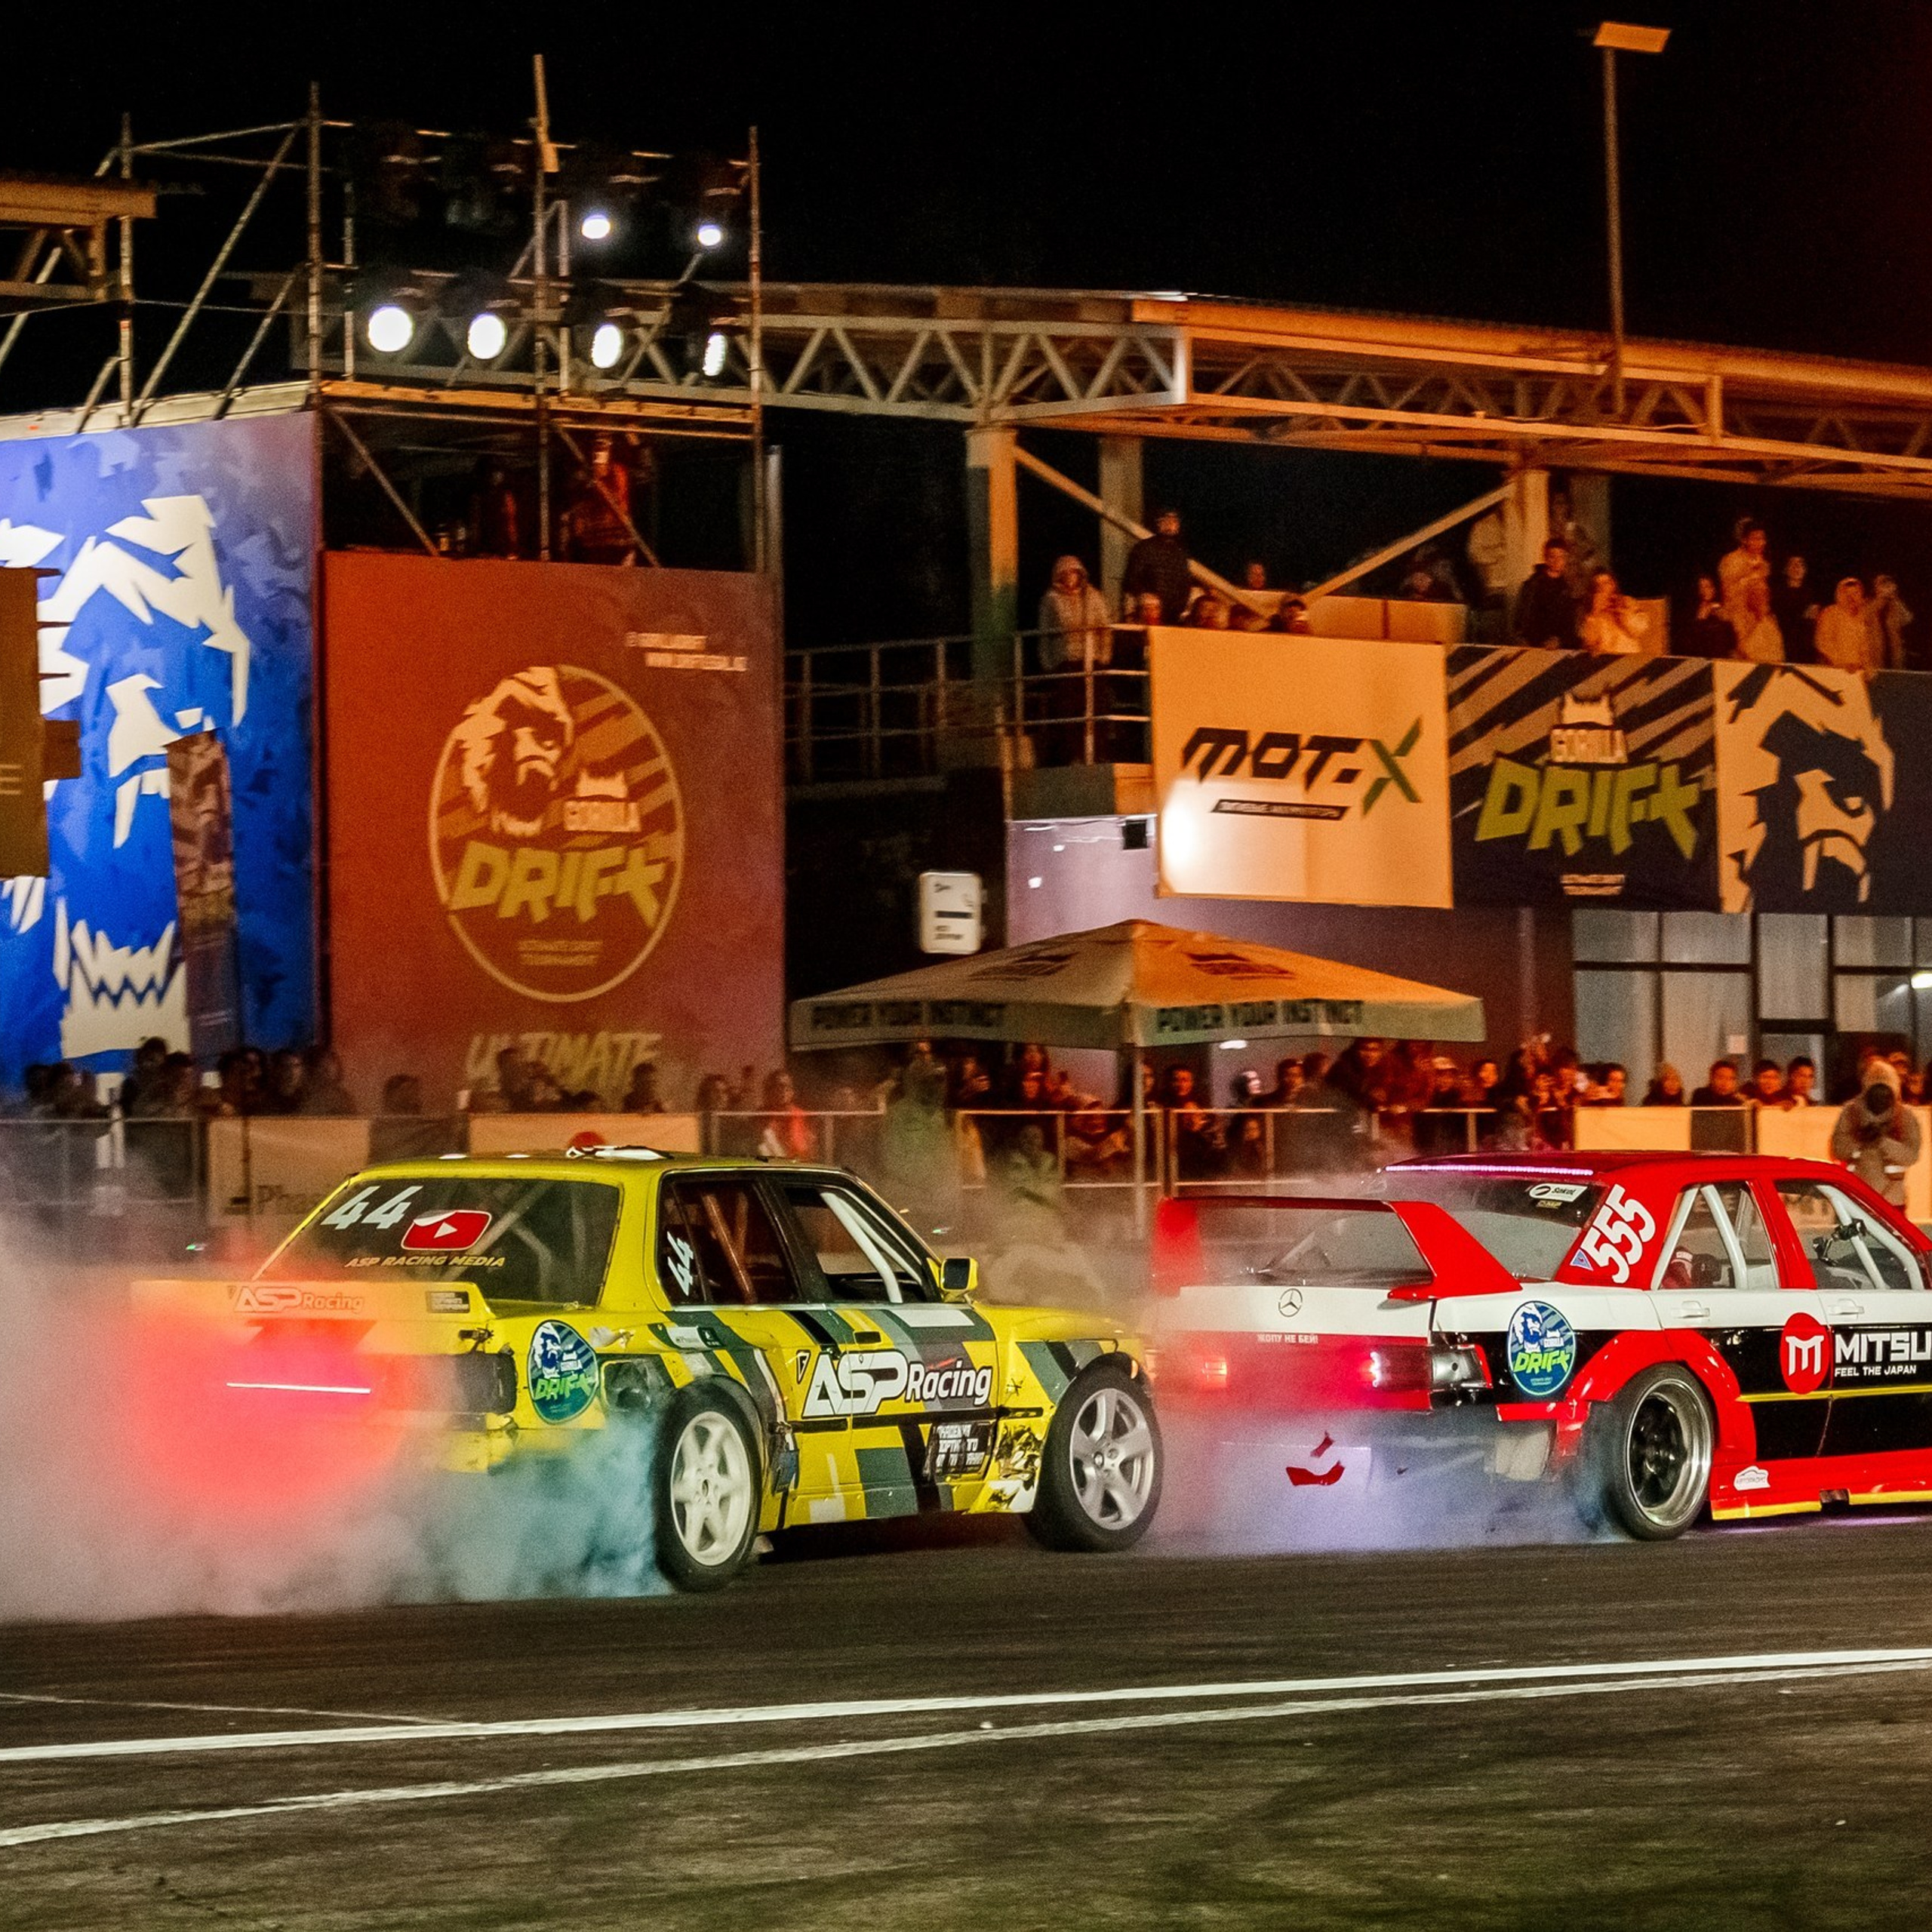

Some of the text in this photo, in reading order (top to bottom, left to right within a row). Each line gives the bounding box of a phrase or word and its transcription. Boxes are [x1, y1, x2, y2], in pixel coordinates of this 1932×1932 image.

[1475, 757, 1700, 860] DRIFT
[451, 841, 669, 928] DRIFT
[320, 1186, 423, 1229] 44
[1580, 1183, 1656, 1284] 555
[345, 1257, 505, 1267] ASP RACING MEDIA
[667, 1231, 694, 1296] 44
[233, 1286, 364, 1313] ASP Racing
[1284, 1334, 1296, 1343] НЕ
[1835, 1331, 1932, 1363] MITSU
[1514, 1350, 1570, 1374] DRIFT
[1835, 1365, 1916, 1377] FEEL THE JAPAN
[534, 1373, 594, 1400] DRIFT
[802, 1351, 992, 1417] ASP Racing
